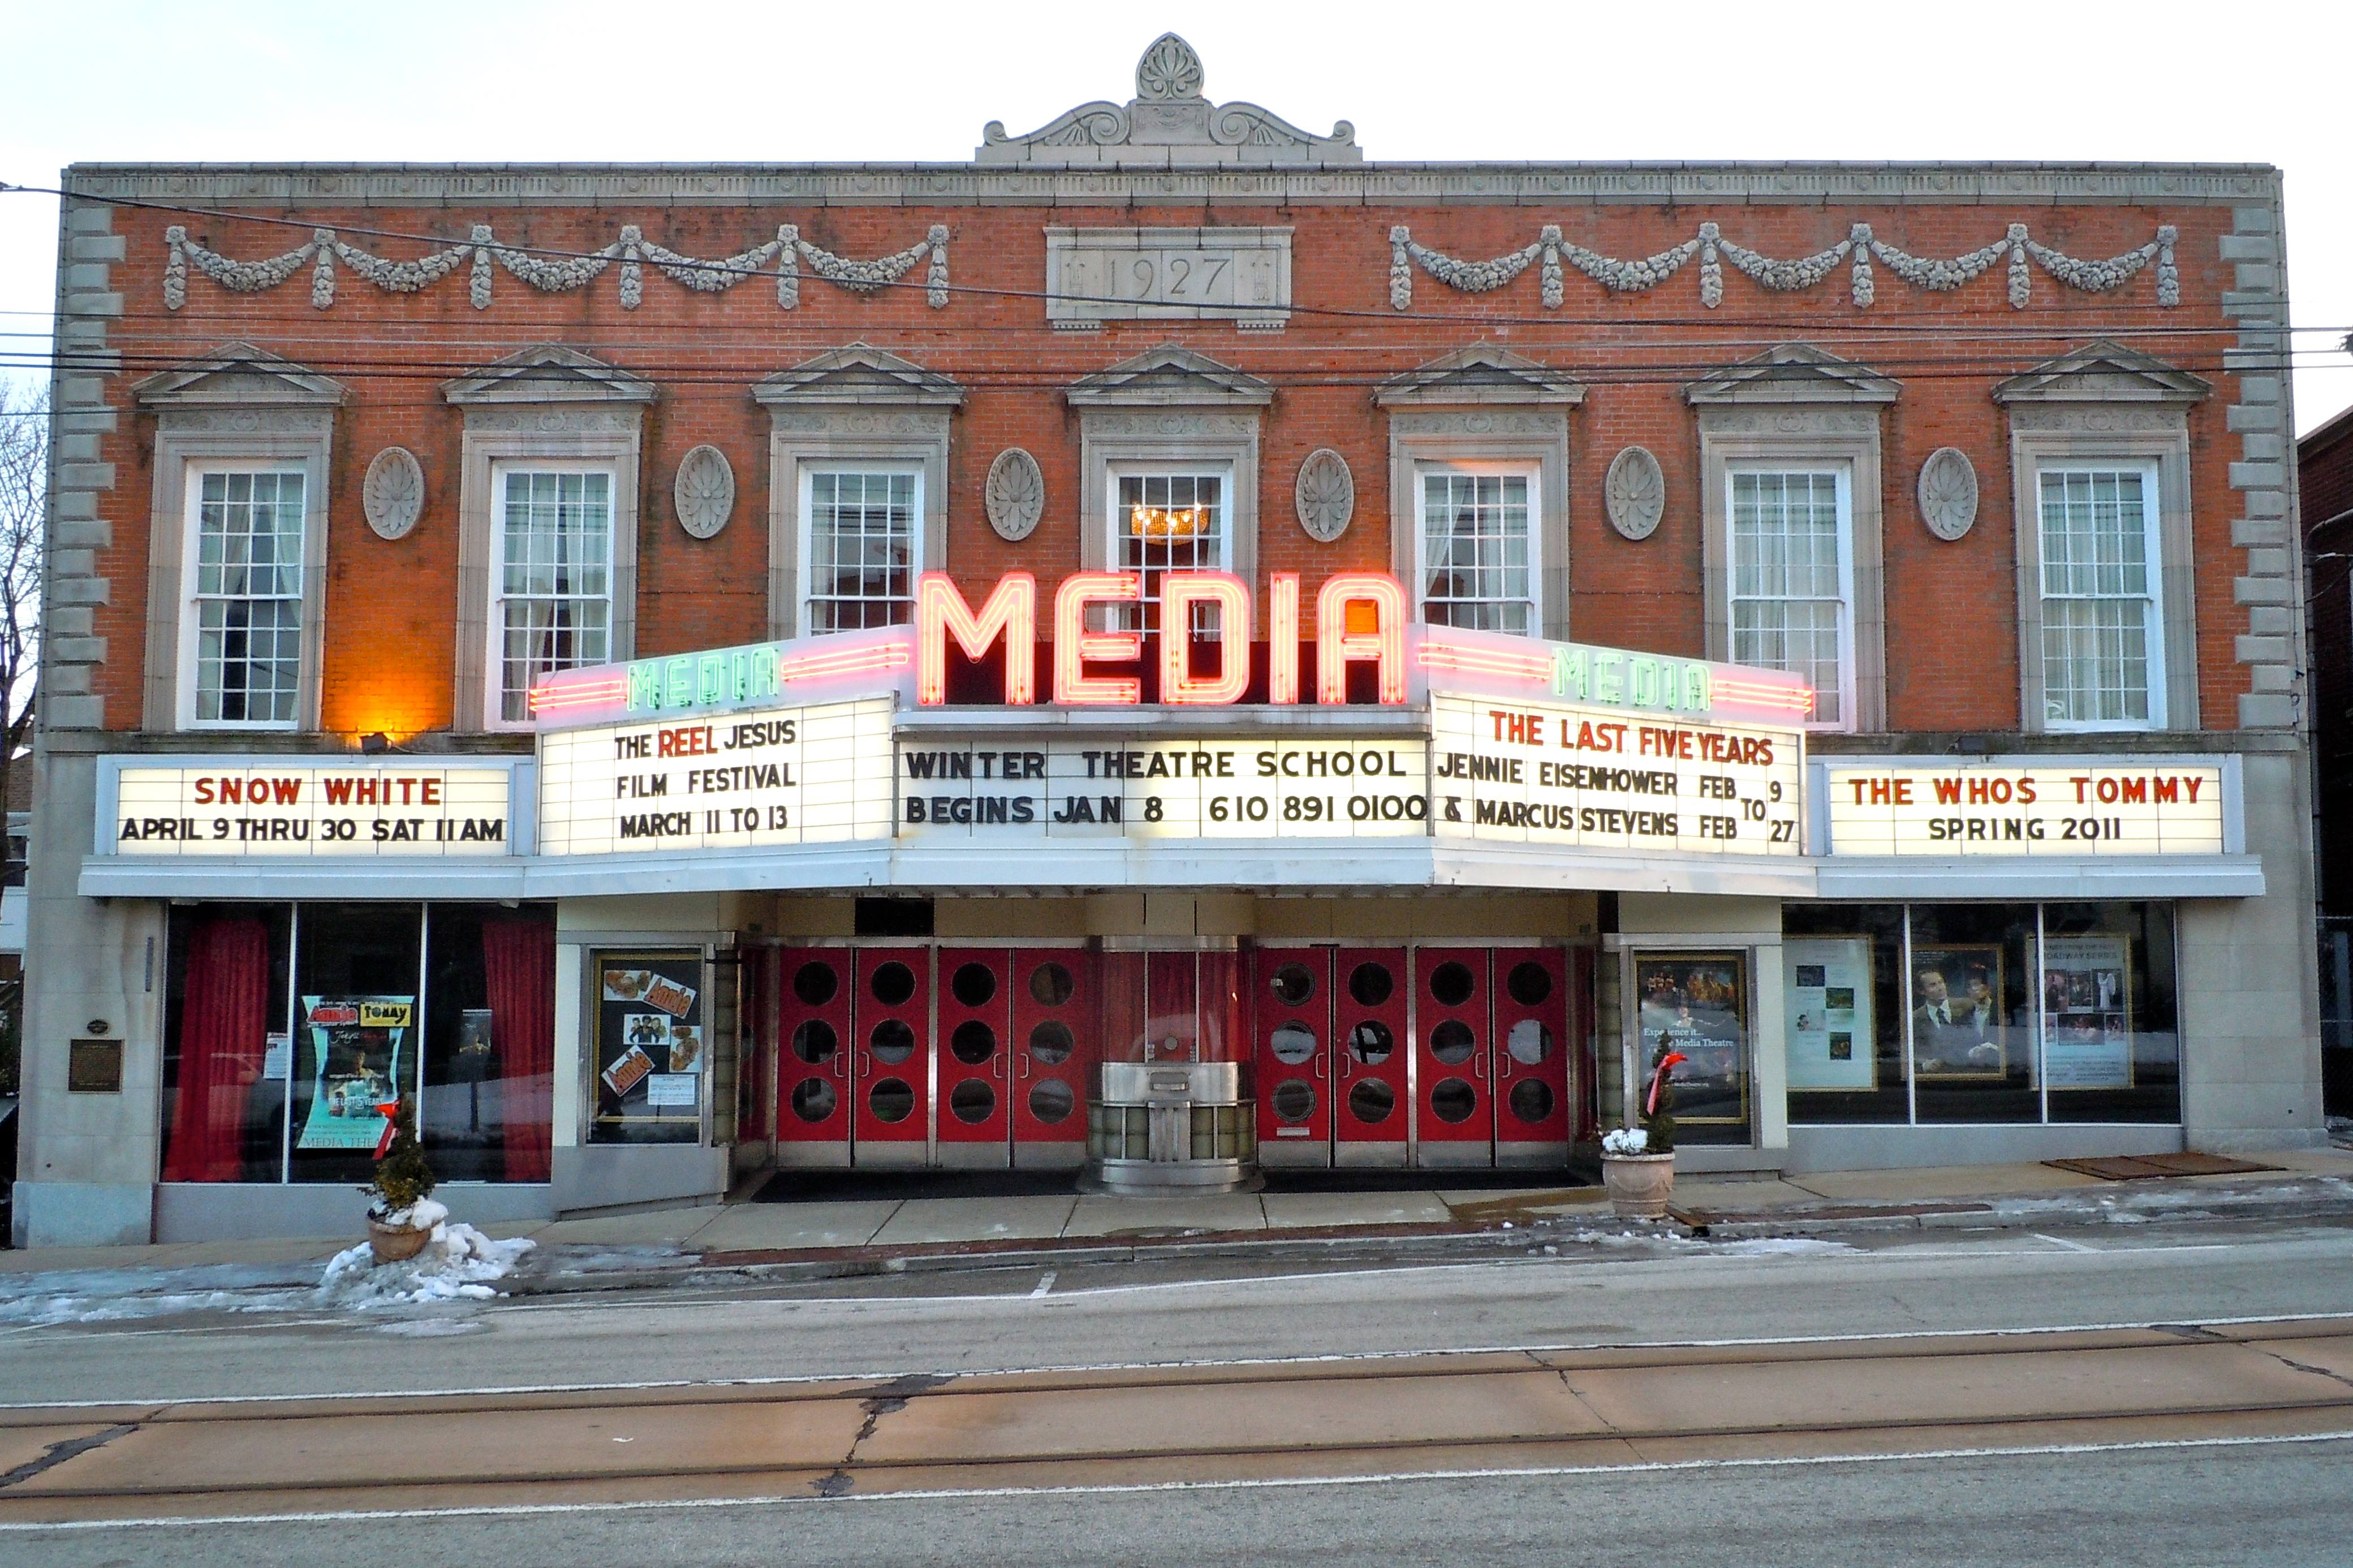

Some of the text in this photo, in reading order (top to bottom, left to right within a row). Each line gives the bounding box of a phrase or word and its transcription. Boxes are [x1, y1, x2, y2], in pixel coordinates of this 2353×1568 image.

[1109, 258, 1231, 299] 1927
[917, 571, 1408, 705] MEDIA
[627, 647, 778, 711] MEDIA
[1553, 648, 1710, 711] MEDIA
[615, 720, 796, 760] THE REEL JESUS
[1489, 710, 1774, 767] THE LAST FIVE YEARS
[617, 762, 796, 800] FILM FESTIVAL
[906, 750, 1407, 780] WINTER THEATRE SCHOOL
[1437, 752, 1782, 802] JENNIE EISENHOWER FEB 9
[194, 777, 441, 805] SNOW WHITE
[1848, 776, 2204, 805] THE WHOS TOMMY
[620, 806, 788, 839] MARCH 11 TO 13
[906, 794, 1428, 824] BEGINS JAN 8 610 891 0100
[1445, 796, 1794, 843] & MARCUS STEVENS FEB 27
[1741, 798, 1765, 822] TO
[120, 818, 502, 841] APRIL 9 THRU 30 SAT 11 AM
[1929, 818, 2121, 840] SPRING 2011
[1675, 1038, 1701, 1047] Media
[1701, 1038, 1734, 1047] Theatre
[304, 1137, 344, 1147] MEDIA
